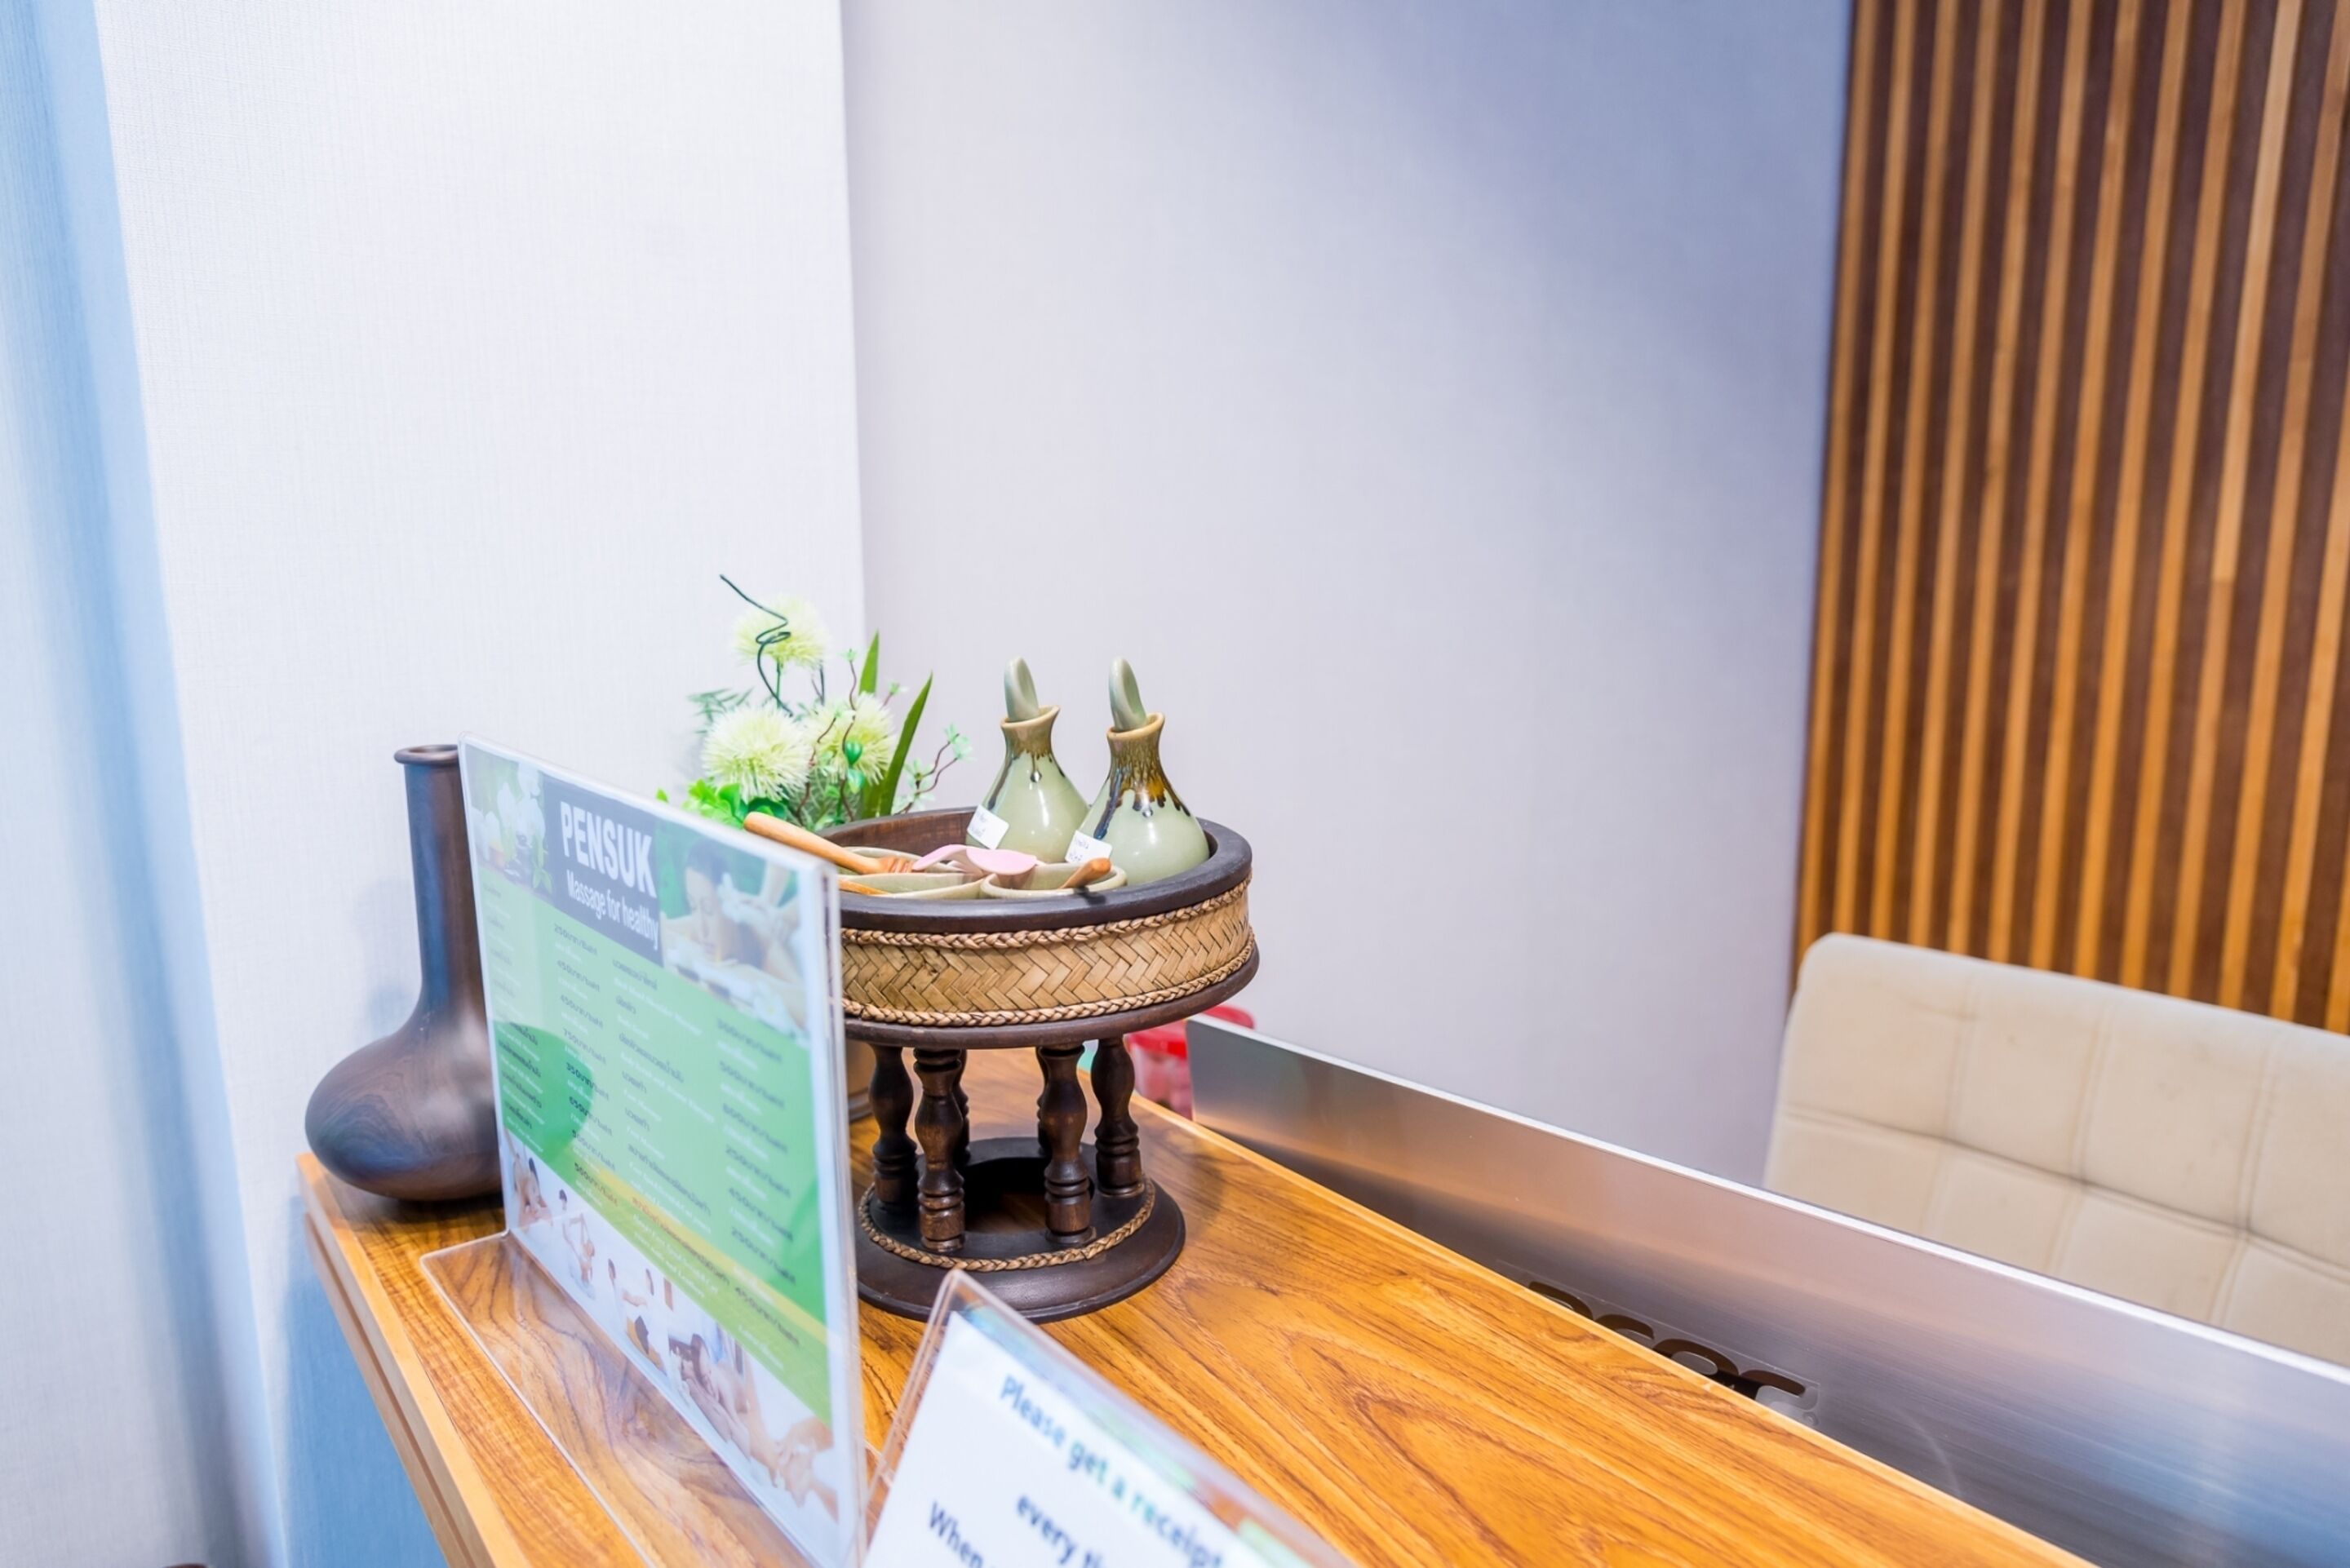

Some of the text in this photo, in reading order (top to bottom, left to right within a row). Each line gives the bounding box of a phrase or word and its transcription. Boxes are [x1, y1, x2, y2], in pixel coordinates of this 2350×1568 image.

[561, 801, 657, 898] PENSUK
[566, 869, 659, 951] Massage for healthy
[1000, 1374, 1066, 1448] Please
[1067, 1441, 1107, 1484] get
[1112, 1475, 1126, 1500] a
[929, 1499, 983, 1568] When
[1017, 1495, 1077, 1565] every
